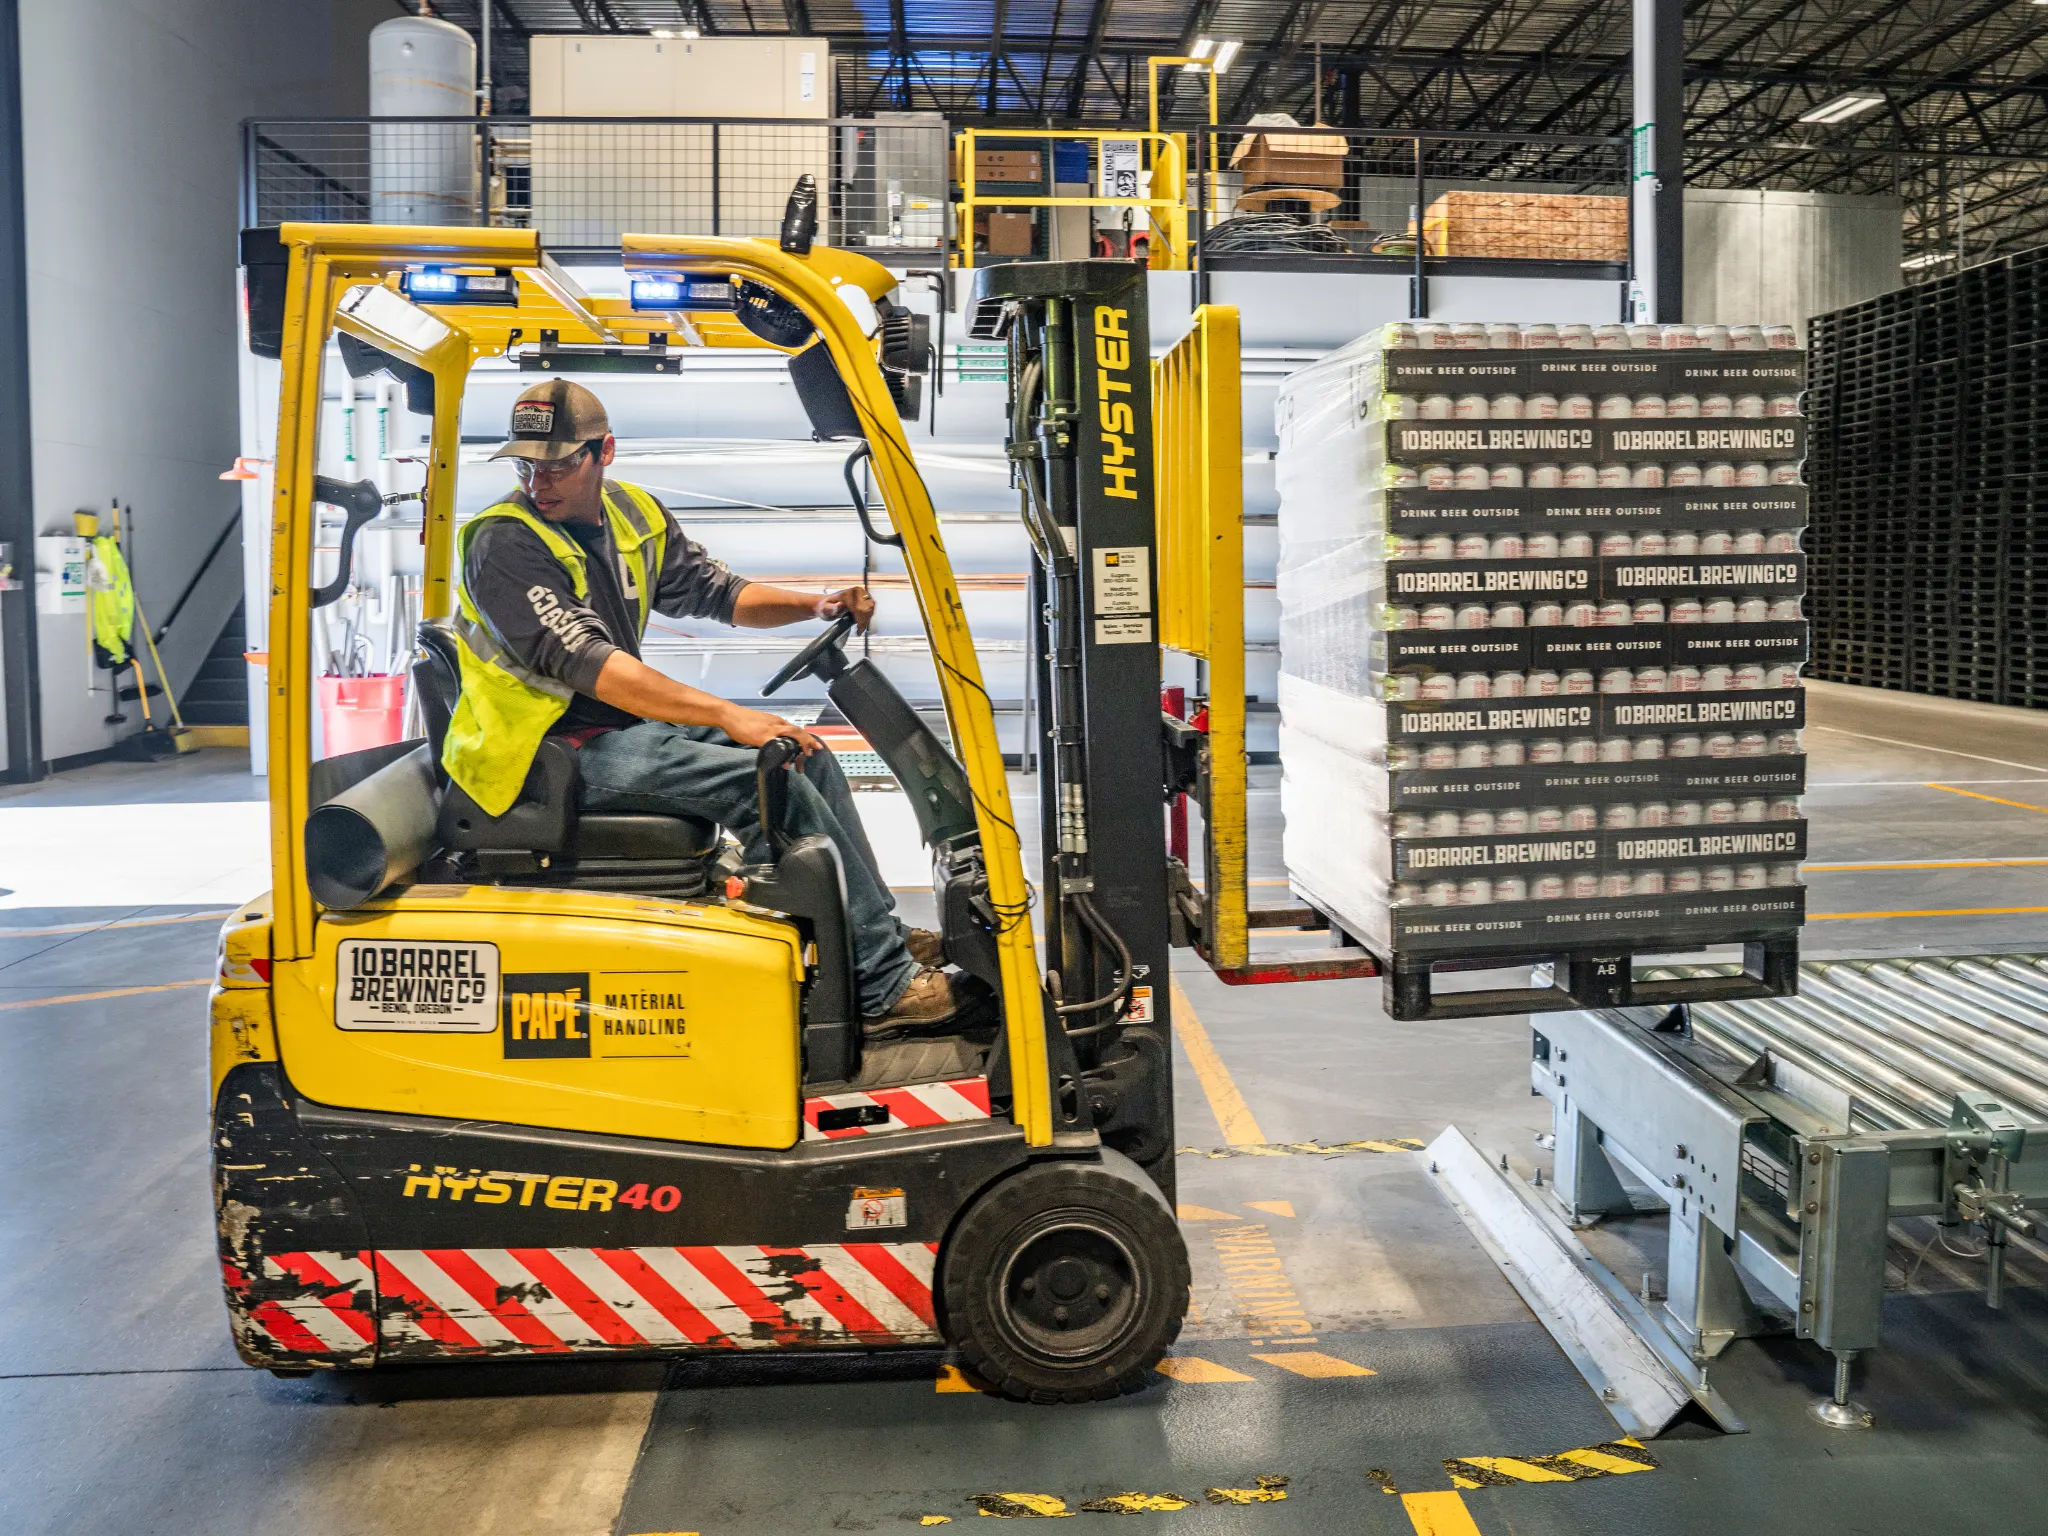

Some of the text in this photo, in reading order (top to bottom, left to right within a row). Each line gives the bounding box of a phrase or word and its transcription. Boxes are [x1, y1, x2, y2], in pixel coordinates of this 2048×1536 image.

[1104, 152, 1114, 181] LEDGE
[1396, 366, 1517, 375] DRINK BEER OUTSIDE
[1541, 363, 1658, 372] DRINK BEER OUTSIDE
[1685, 367, 1798, 378] DRINK BEER OUTSIDE
[1094, 305, 1138, 500] HYSTER
[1546, 507, 1662, 517] DRINK BEER OUTSIDE
[1685, 501, 1797, 511] DRINK BEER OUTSIDE
[1400, 508, 1520, 518] DRINK BEER OUTSIDE
[1399, 643, 1519, 655] DRINK BEER OUTSIDE
[1546, 640, 1662, 652] DRINK BEER OUTSIDE
[1687, 638, 1799, 649] DRINK BEER OUTSIDE
[1545, 774, 1660, 787] DRINK BEER OUTSIDE
[1686, 773, 1797, 786] DRINK BEER OUTSIDE
[1402, 781, 1521, 796] DRINK BEER OUTSIDE
[1684, 901, 1795, 916] DRINK BEER OUTSIDE
[1546, 909, 1661, 923] DRINK BEER OUTSIDE
[1404, 920, 1523, 934] DRINK BEER OUTSIDE
[1596, 963, 1618, 976] A-B
[604, 993, 686, 1011] MATERIAL
[414, 1003, 452, 1015] OREGON
[604, 1018, 687, 1036] HANDLING
[402, 1163, 682, 1213] HYSTER 40
